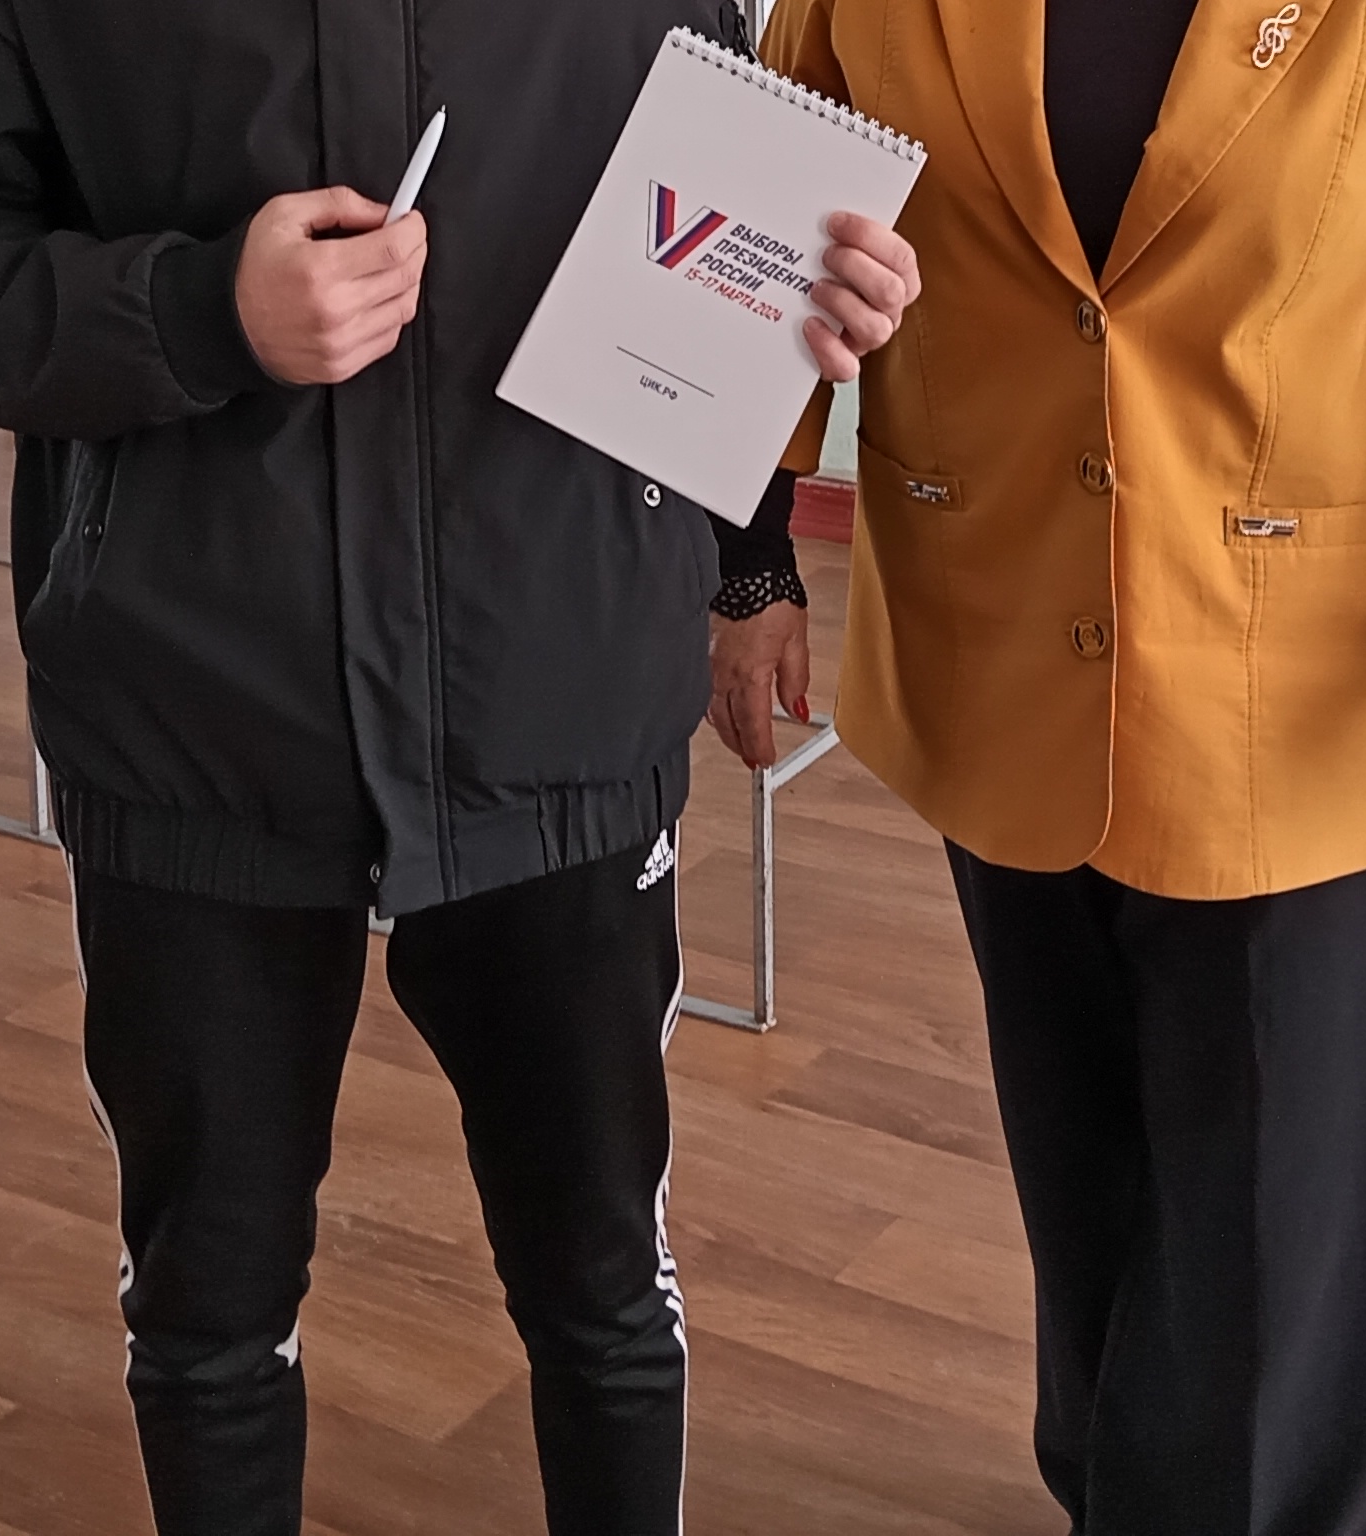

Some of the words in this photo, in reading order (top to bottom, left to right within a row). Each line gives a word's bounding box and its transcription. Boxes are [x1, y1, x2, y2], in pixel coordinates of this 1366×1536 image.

[729, 222, 804, 266] ВЫБОРЫ
[696, 252, 766, 293] РОССИИ
[713, 238, 815, 296] ПРЕЗИДЕНТА
[716, 284, 754, 310] МАРТА
[753, 302, 783, 322] 2024
[639, 375, 678, 400] ЦИК.РФ
